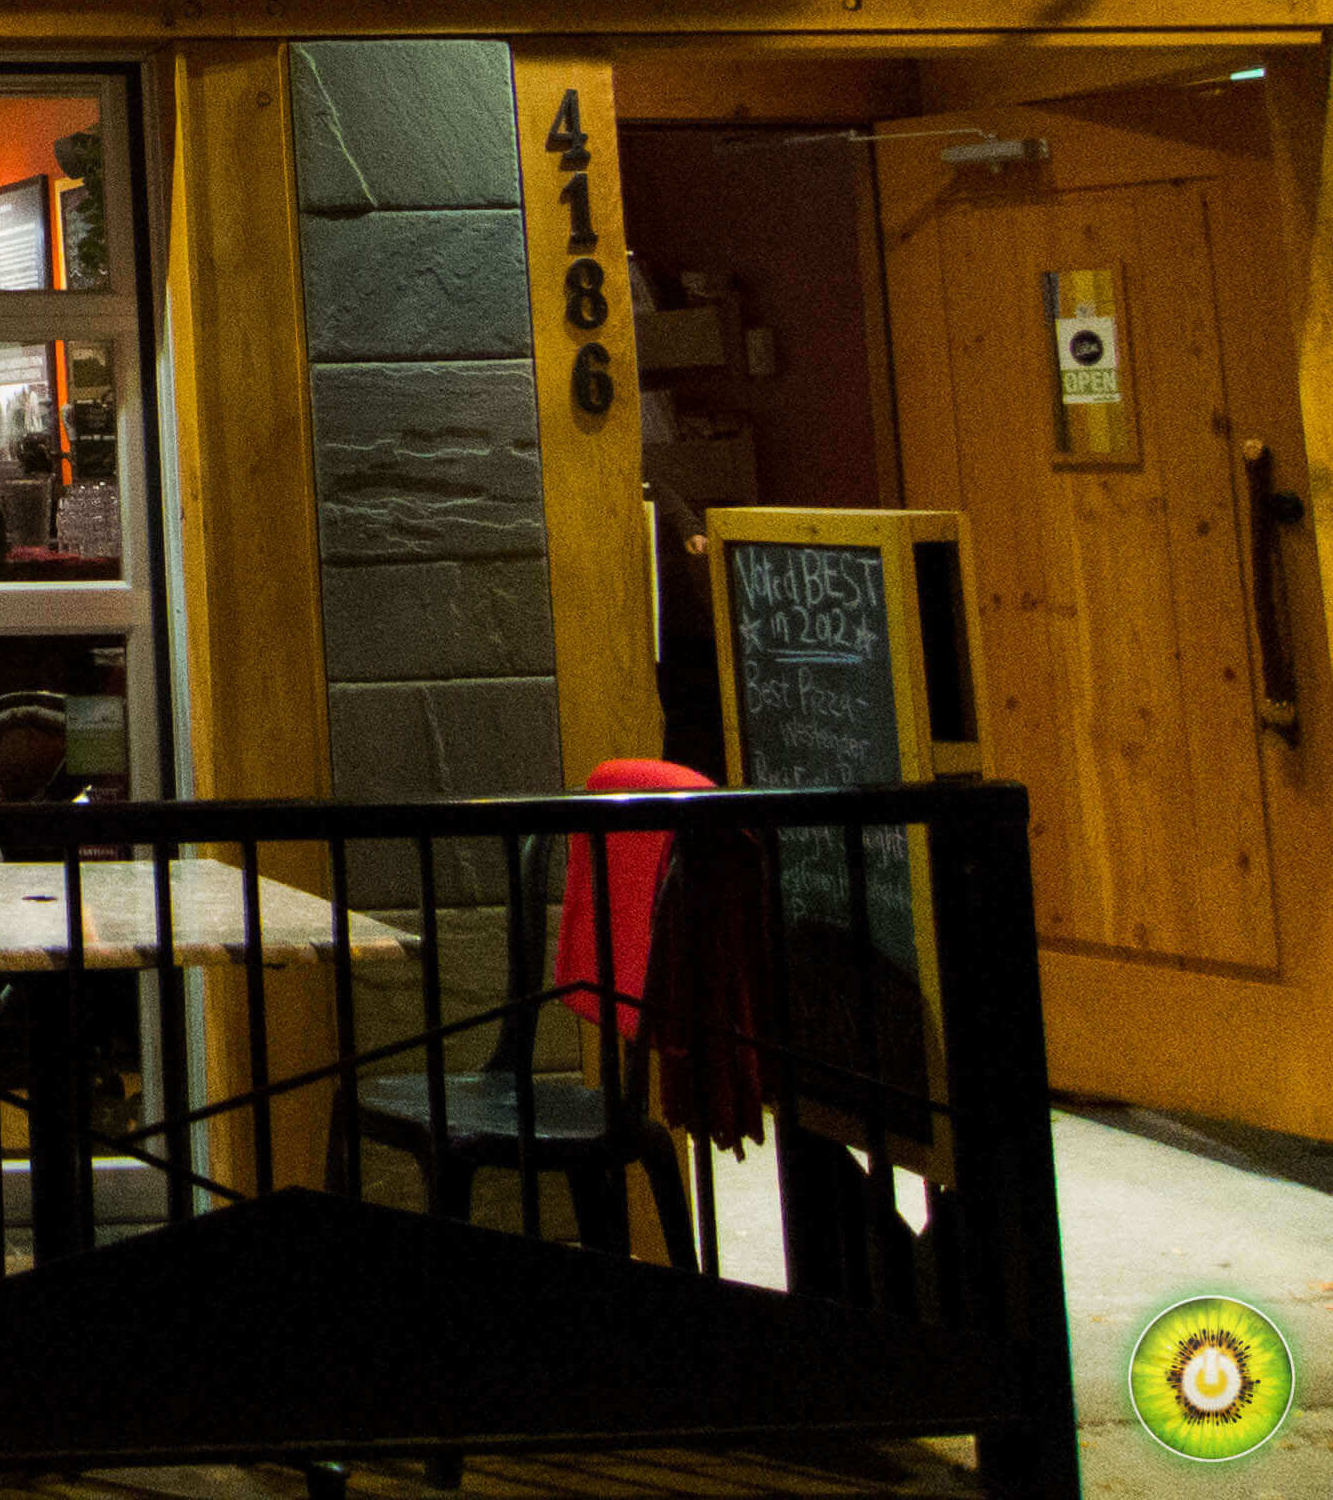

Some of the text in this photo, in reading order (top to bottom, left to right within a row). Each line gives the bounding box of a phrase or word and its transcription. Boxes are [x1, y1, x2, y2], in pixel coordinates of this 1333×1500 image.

[545, 88, 613, 414] 4186
[1066, 371, 1117, 392] OPEN
[803, 549, 879, 609] BEST
